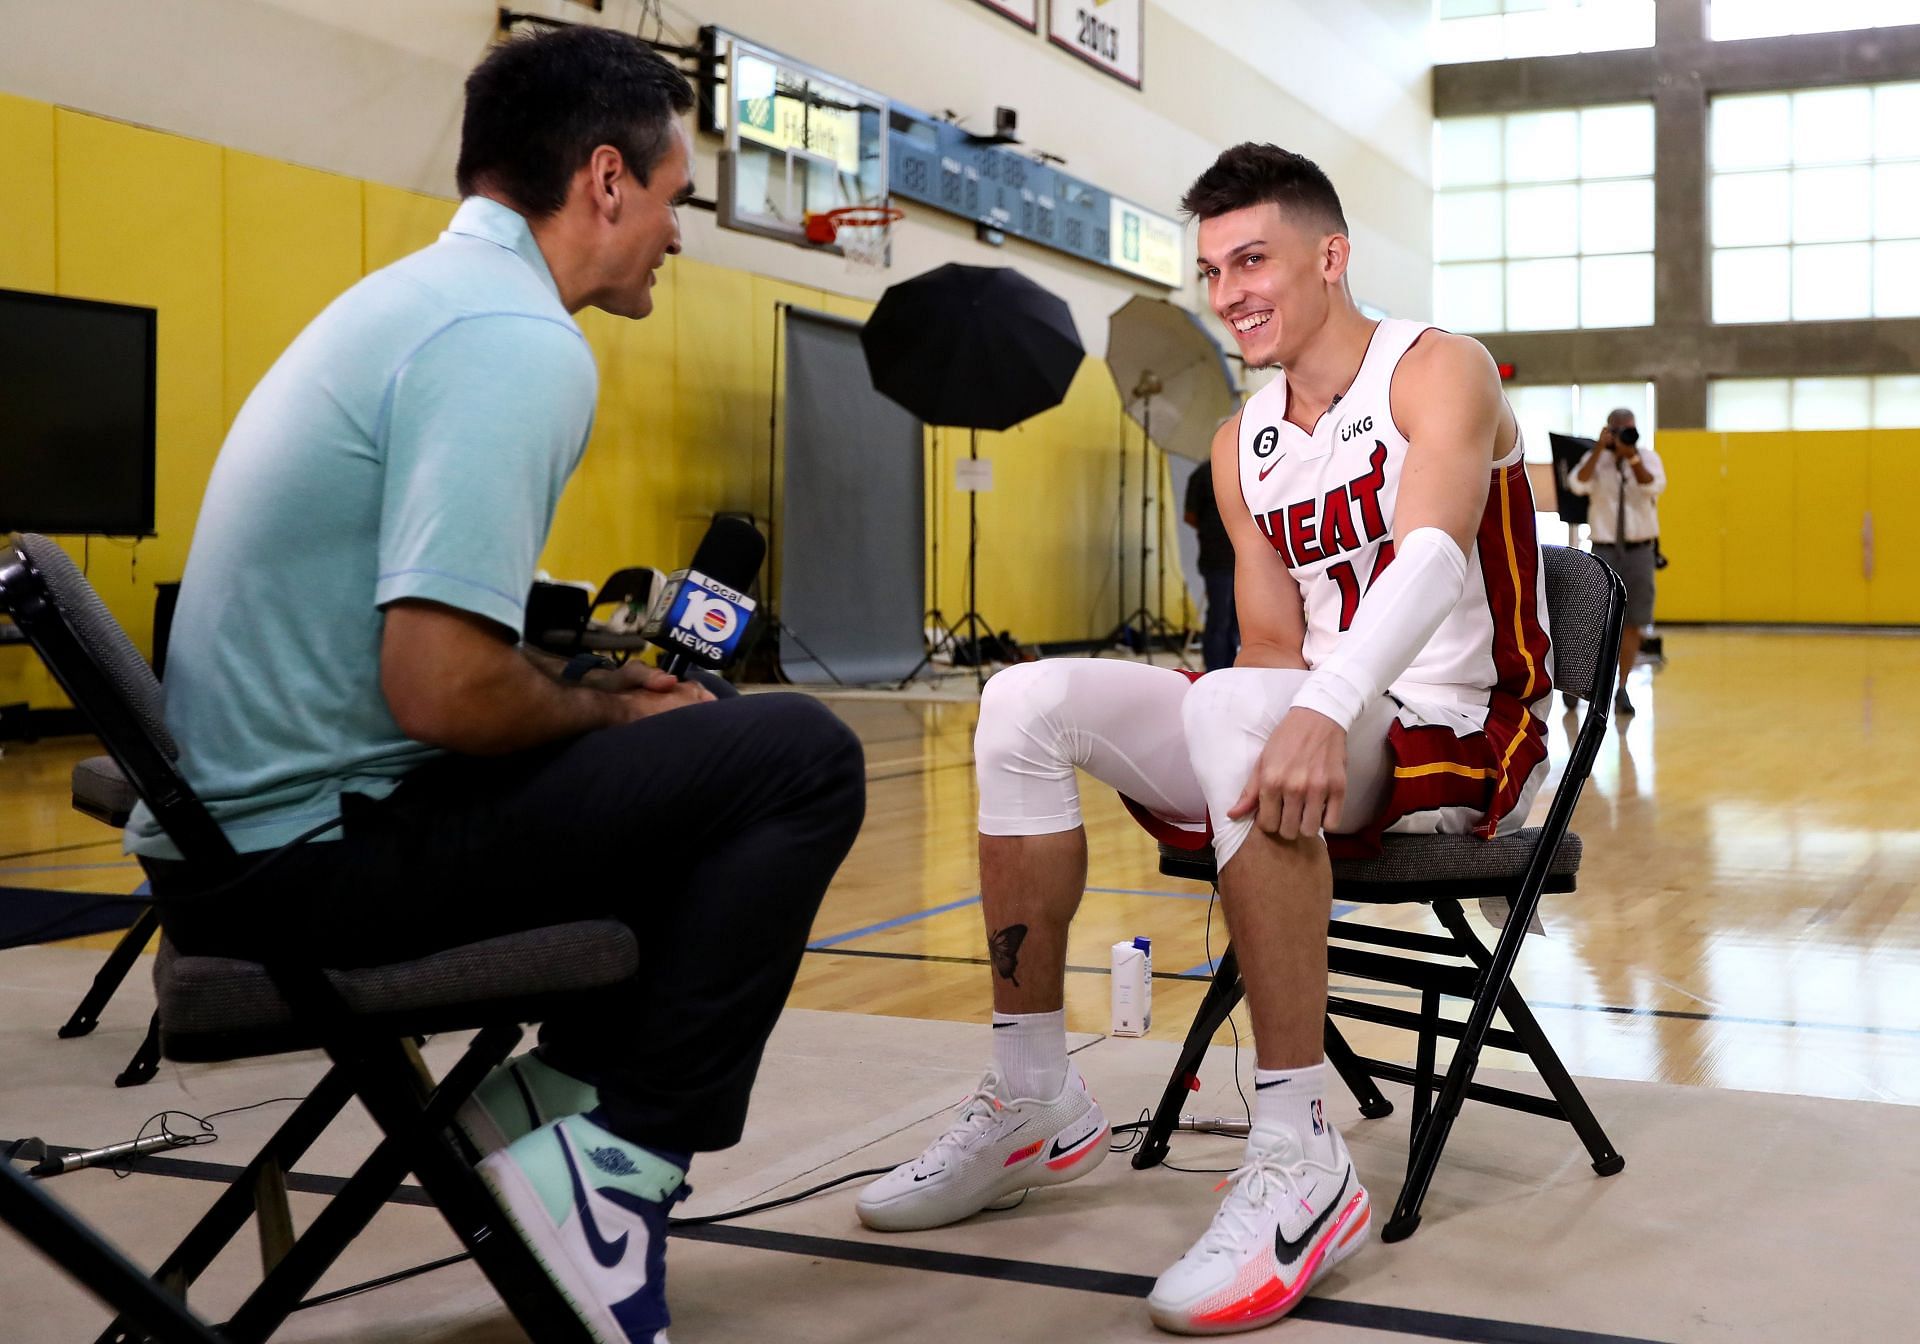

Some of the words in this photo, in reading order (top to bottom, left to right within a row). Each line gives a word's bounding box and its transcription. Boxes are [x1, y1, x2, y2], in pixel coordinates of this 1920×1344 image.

[1077, 8, 1119, 61] 2013
[1258, 430, 1275, 454] 6
[1254, 439, 1388, 569] HEAT
[703, 578, 742, 604] Local
[678, 590, 737, 643] 10
[669, 626, 722, 660] NEWS
